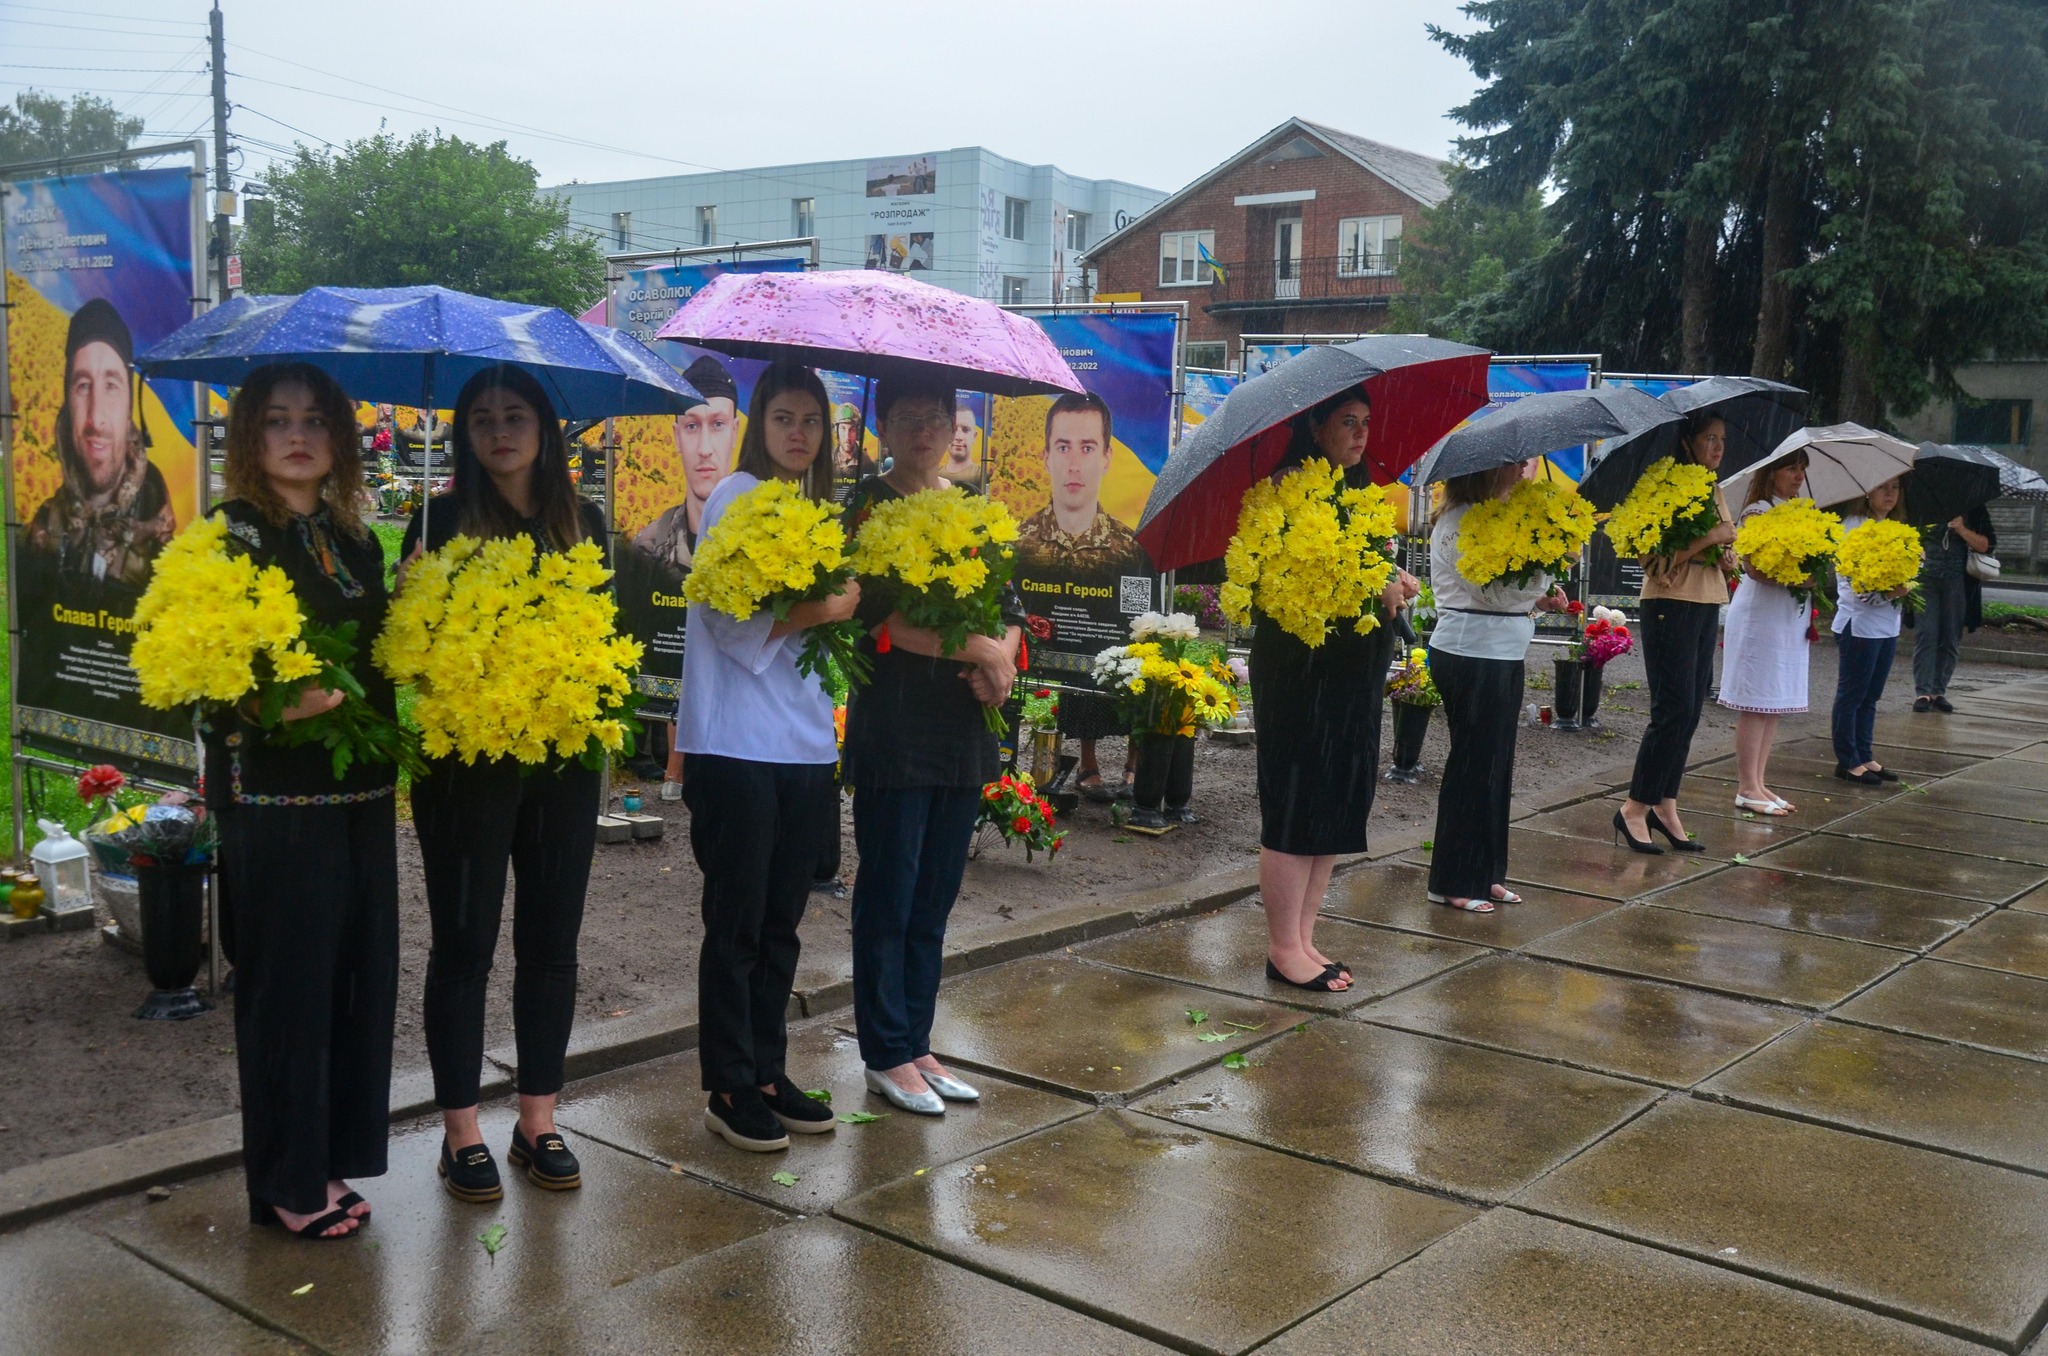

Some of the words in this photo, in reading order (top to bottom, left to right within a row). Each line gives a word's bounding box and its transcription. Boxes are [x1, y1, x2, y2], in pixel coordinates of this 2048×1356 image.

[18, 235, 54, 253] Денис
[56, 233, 107, 248] Олегович
[628, 286, 692, 302] ОСАВОЛЮК
[628, 308, 664, 323] Сергій
[1060, 347, 1094, 357] ійович
[1021, 578, 1062, 594] Слава
[1065, 582, 1113, 598] Герою!
[53, 603, 96, 628] Слава
